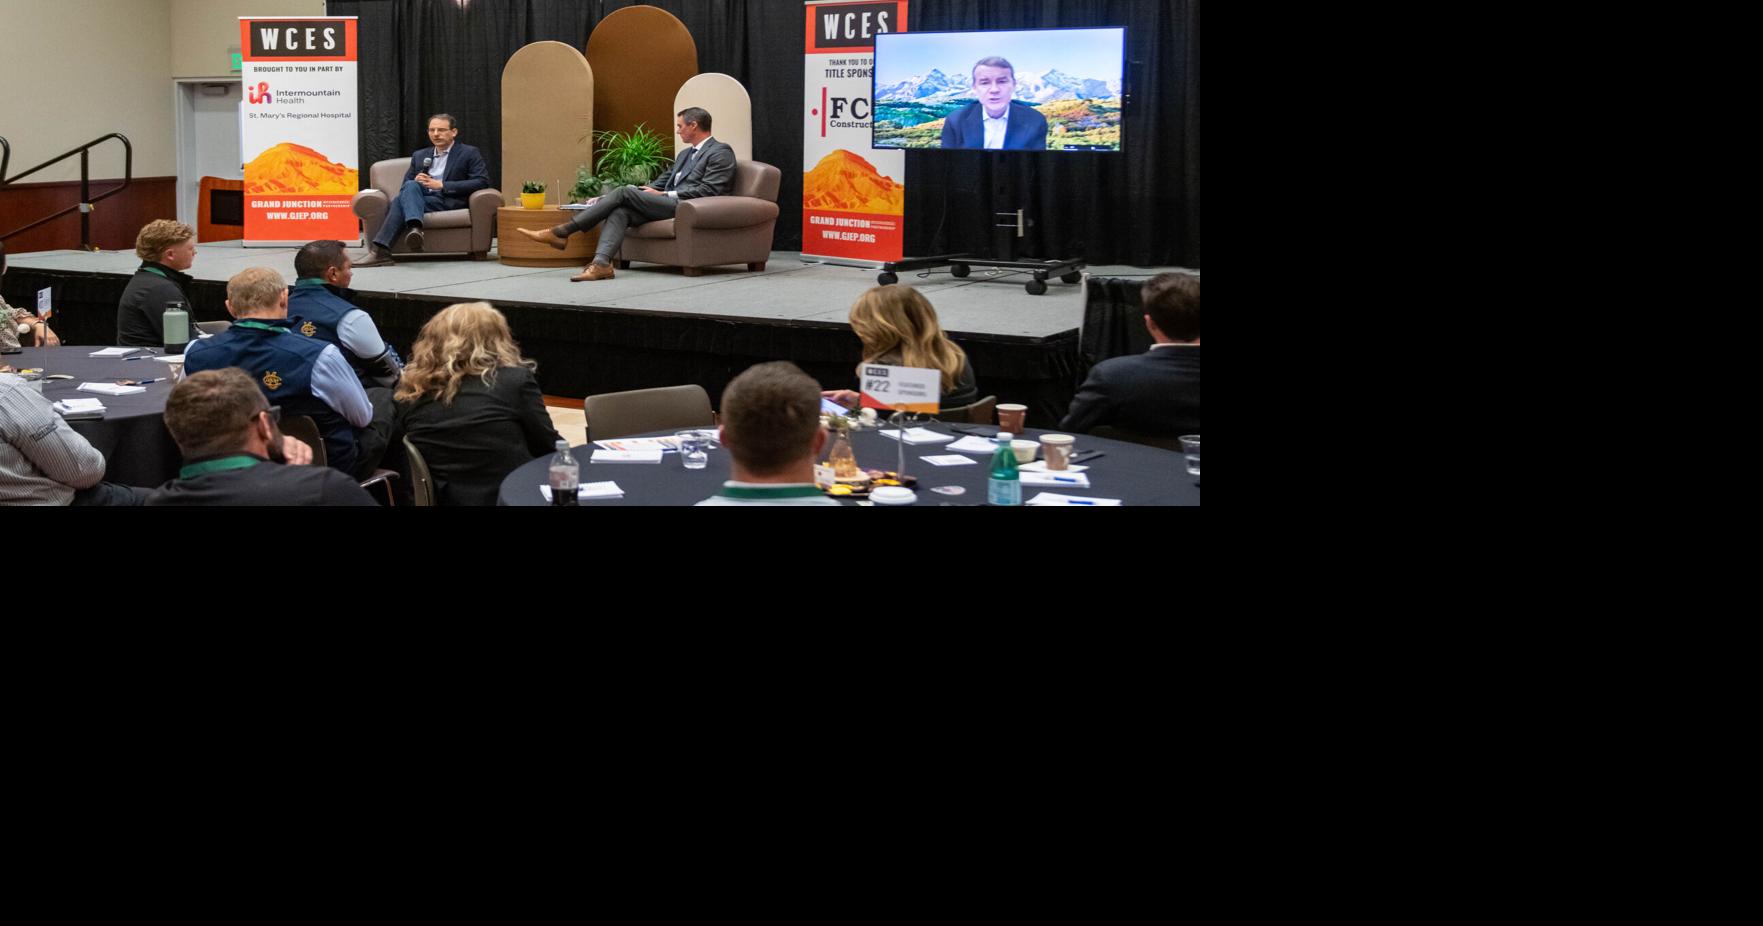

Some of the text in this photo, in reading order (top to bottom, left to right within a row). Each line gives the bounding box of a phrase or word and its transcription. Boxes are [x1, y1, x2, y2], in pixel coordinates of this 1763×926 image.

[823, 11, 889, 40] WCES
[260, 27, 336, 50] WCES
[825, 69, 845, 78] TITLE
[830, 97, 873, 119] FC
[260, 112, 285, 120] Mary's
[287, 112, 319, 120] Regional
[320, 112, 351, 120] Hospital
[251, 200, 281, 208] GRAND
[283, 200, 322, 208] JUNCTION
[266, 212, 328, 220] WWW.GJEP.ORG
[810, 216, 834, 225] GRAND
[836, 218, 871, 228] JUNCTION
[822, 230, 876, 243] WWW.GJEP.ORG
[866, 379, 890, 392] #22
